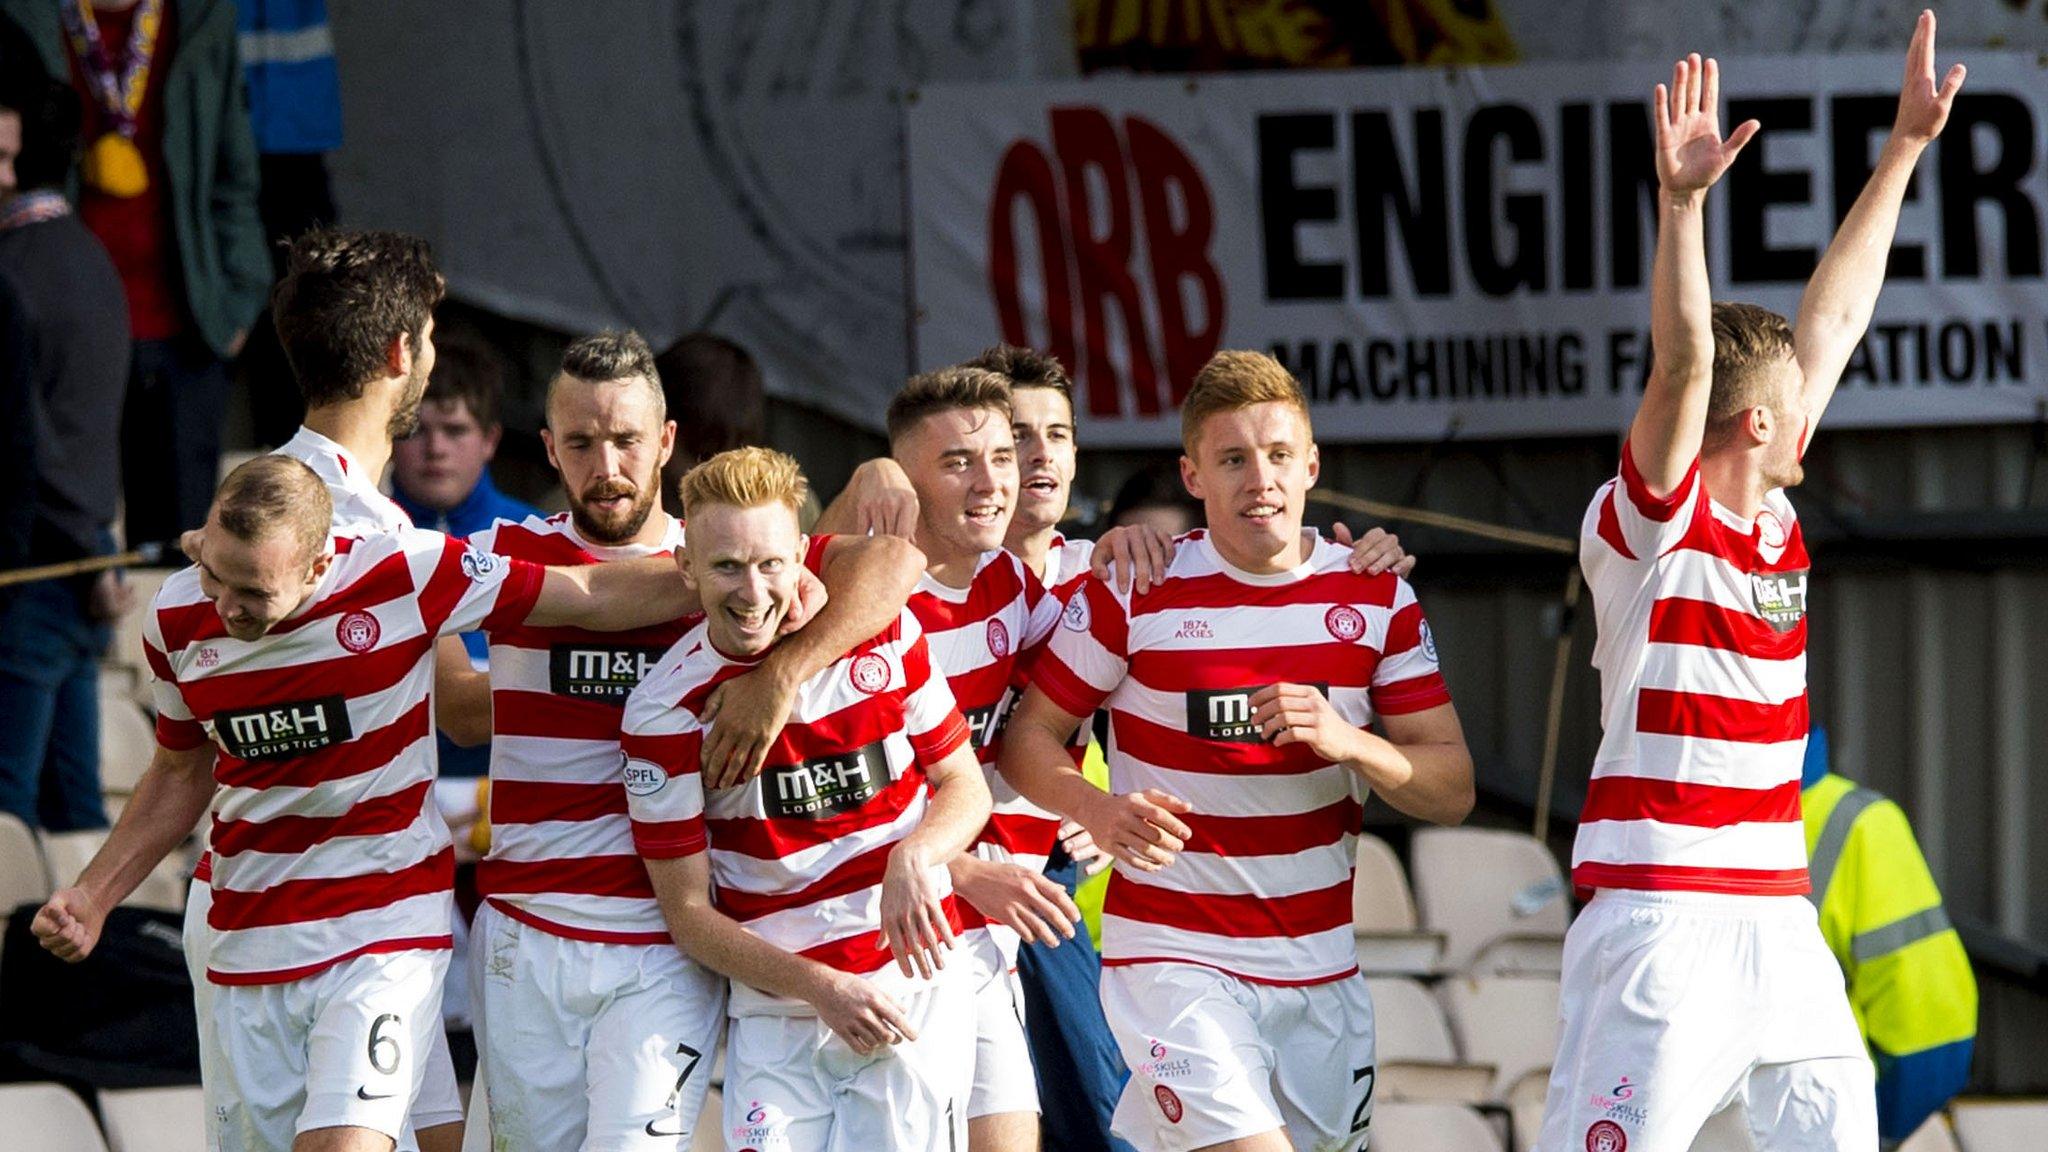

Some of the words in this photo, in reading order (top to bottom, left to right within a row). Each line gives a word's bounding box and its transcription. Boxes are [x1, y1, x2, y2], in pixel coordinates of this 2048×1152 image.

[988, 105, 1228, 420] ORB
[1175, 630, 1214, 639] ACCIES
[1183, 619, 1208, 629] 1874
[230, 704, 328, 743] M&H
[241, 736, 330, 758] LOGISTICS
[626, 768, 658, 782] SPFL
[777, 753, 870, 800] M&H
[782, 786, 874, 814] LOGISTICS
[368, 1013, 401, 1075] 6
[665, 1043, 702, 1110] 7
[1350, 1066, 1374, 1134] 2
